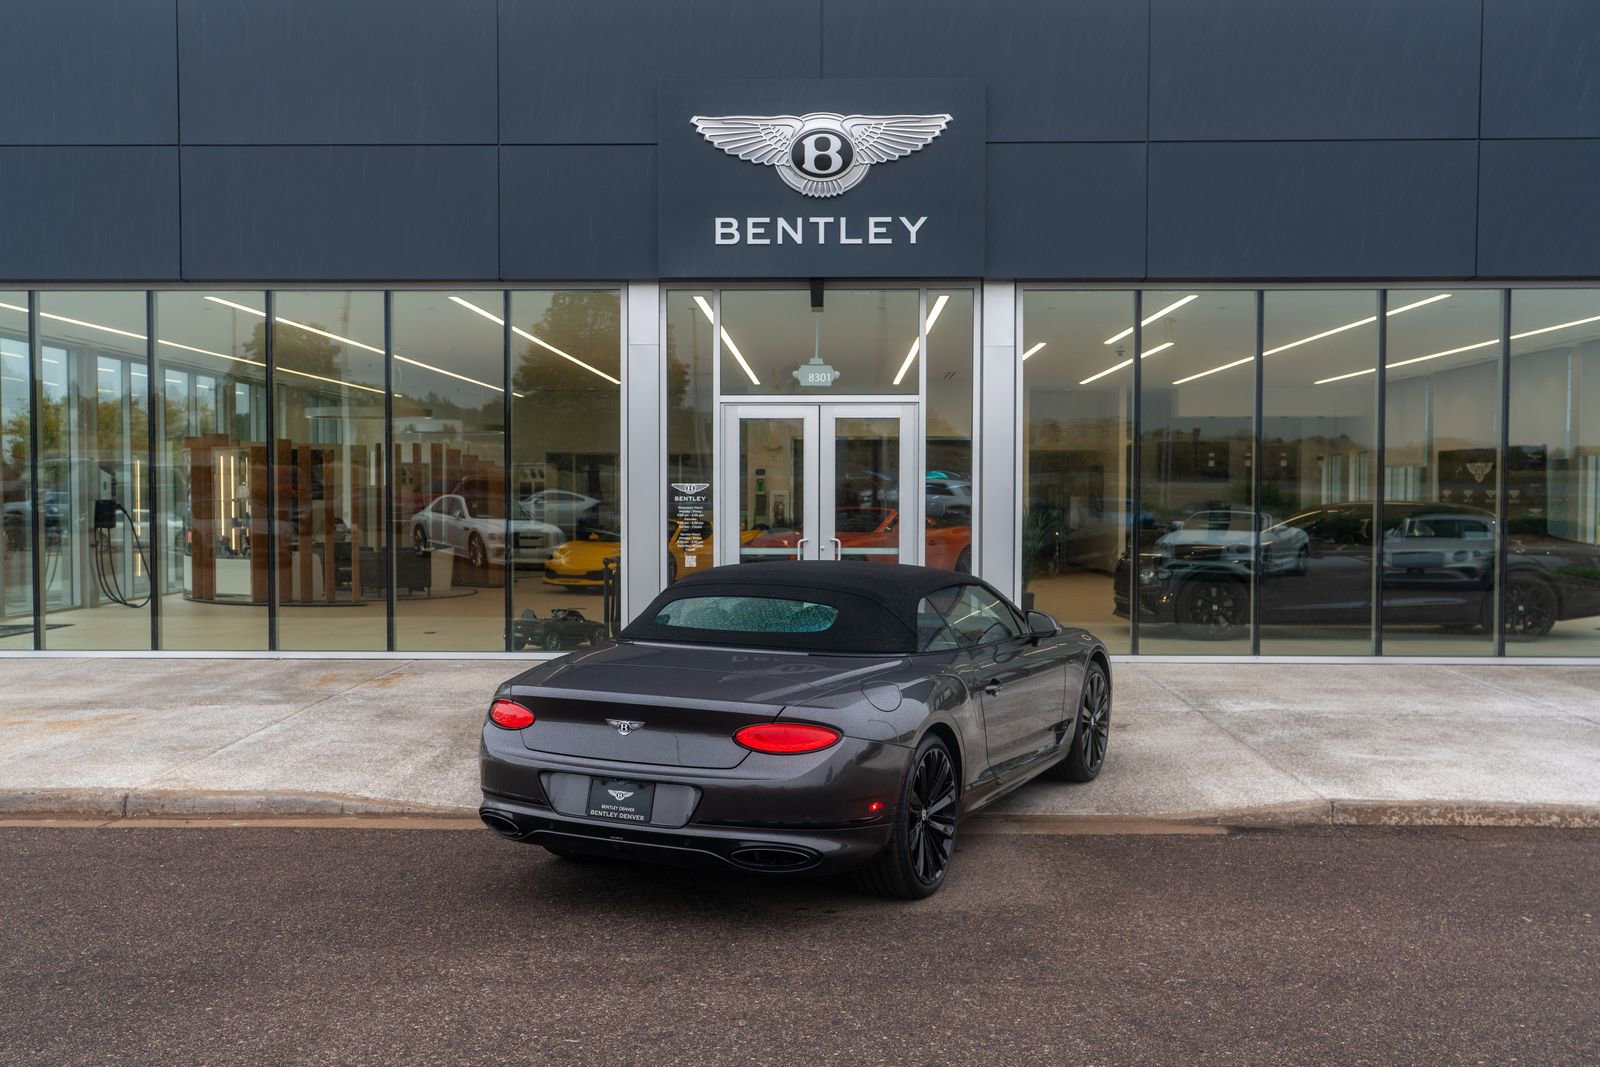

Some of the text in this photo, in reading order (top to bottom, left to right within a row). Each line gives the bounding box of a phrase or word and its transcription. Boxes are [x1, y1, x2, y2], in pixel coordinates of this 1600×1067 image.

[714, 216, 928, 245] BENTLEY
[808, 372, 831, 382] 8301
[590, 809, 645, 821] BENTLEY DENVER
